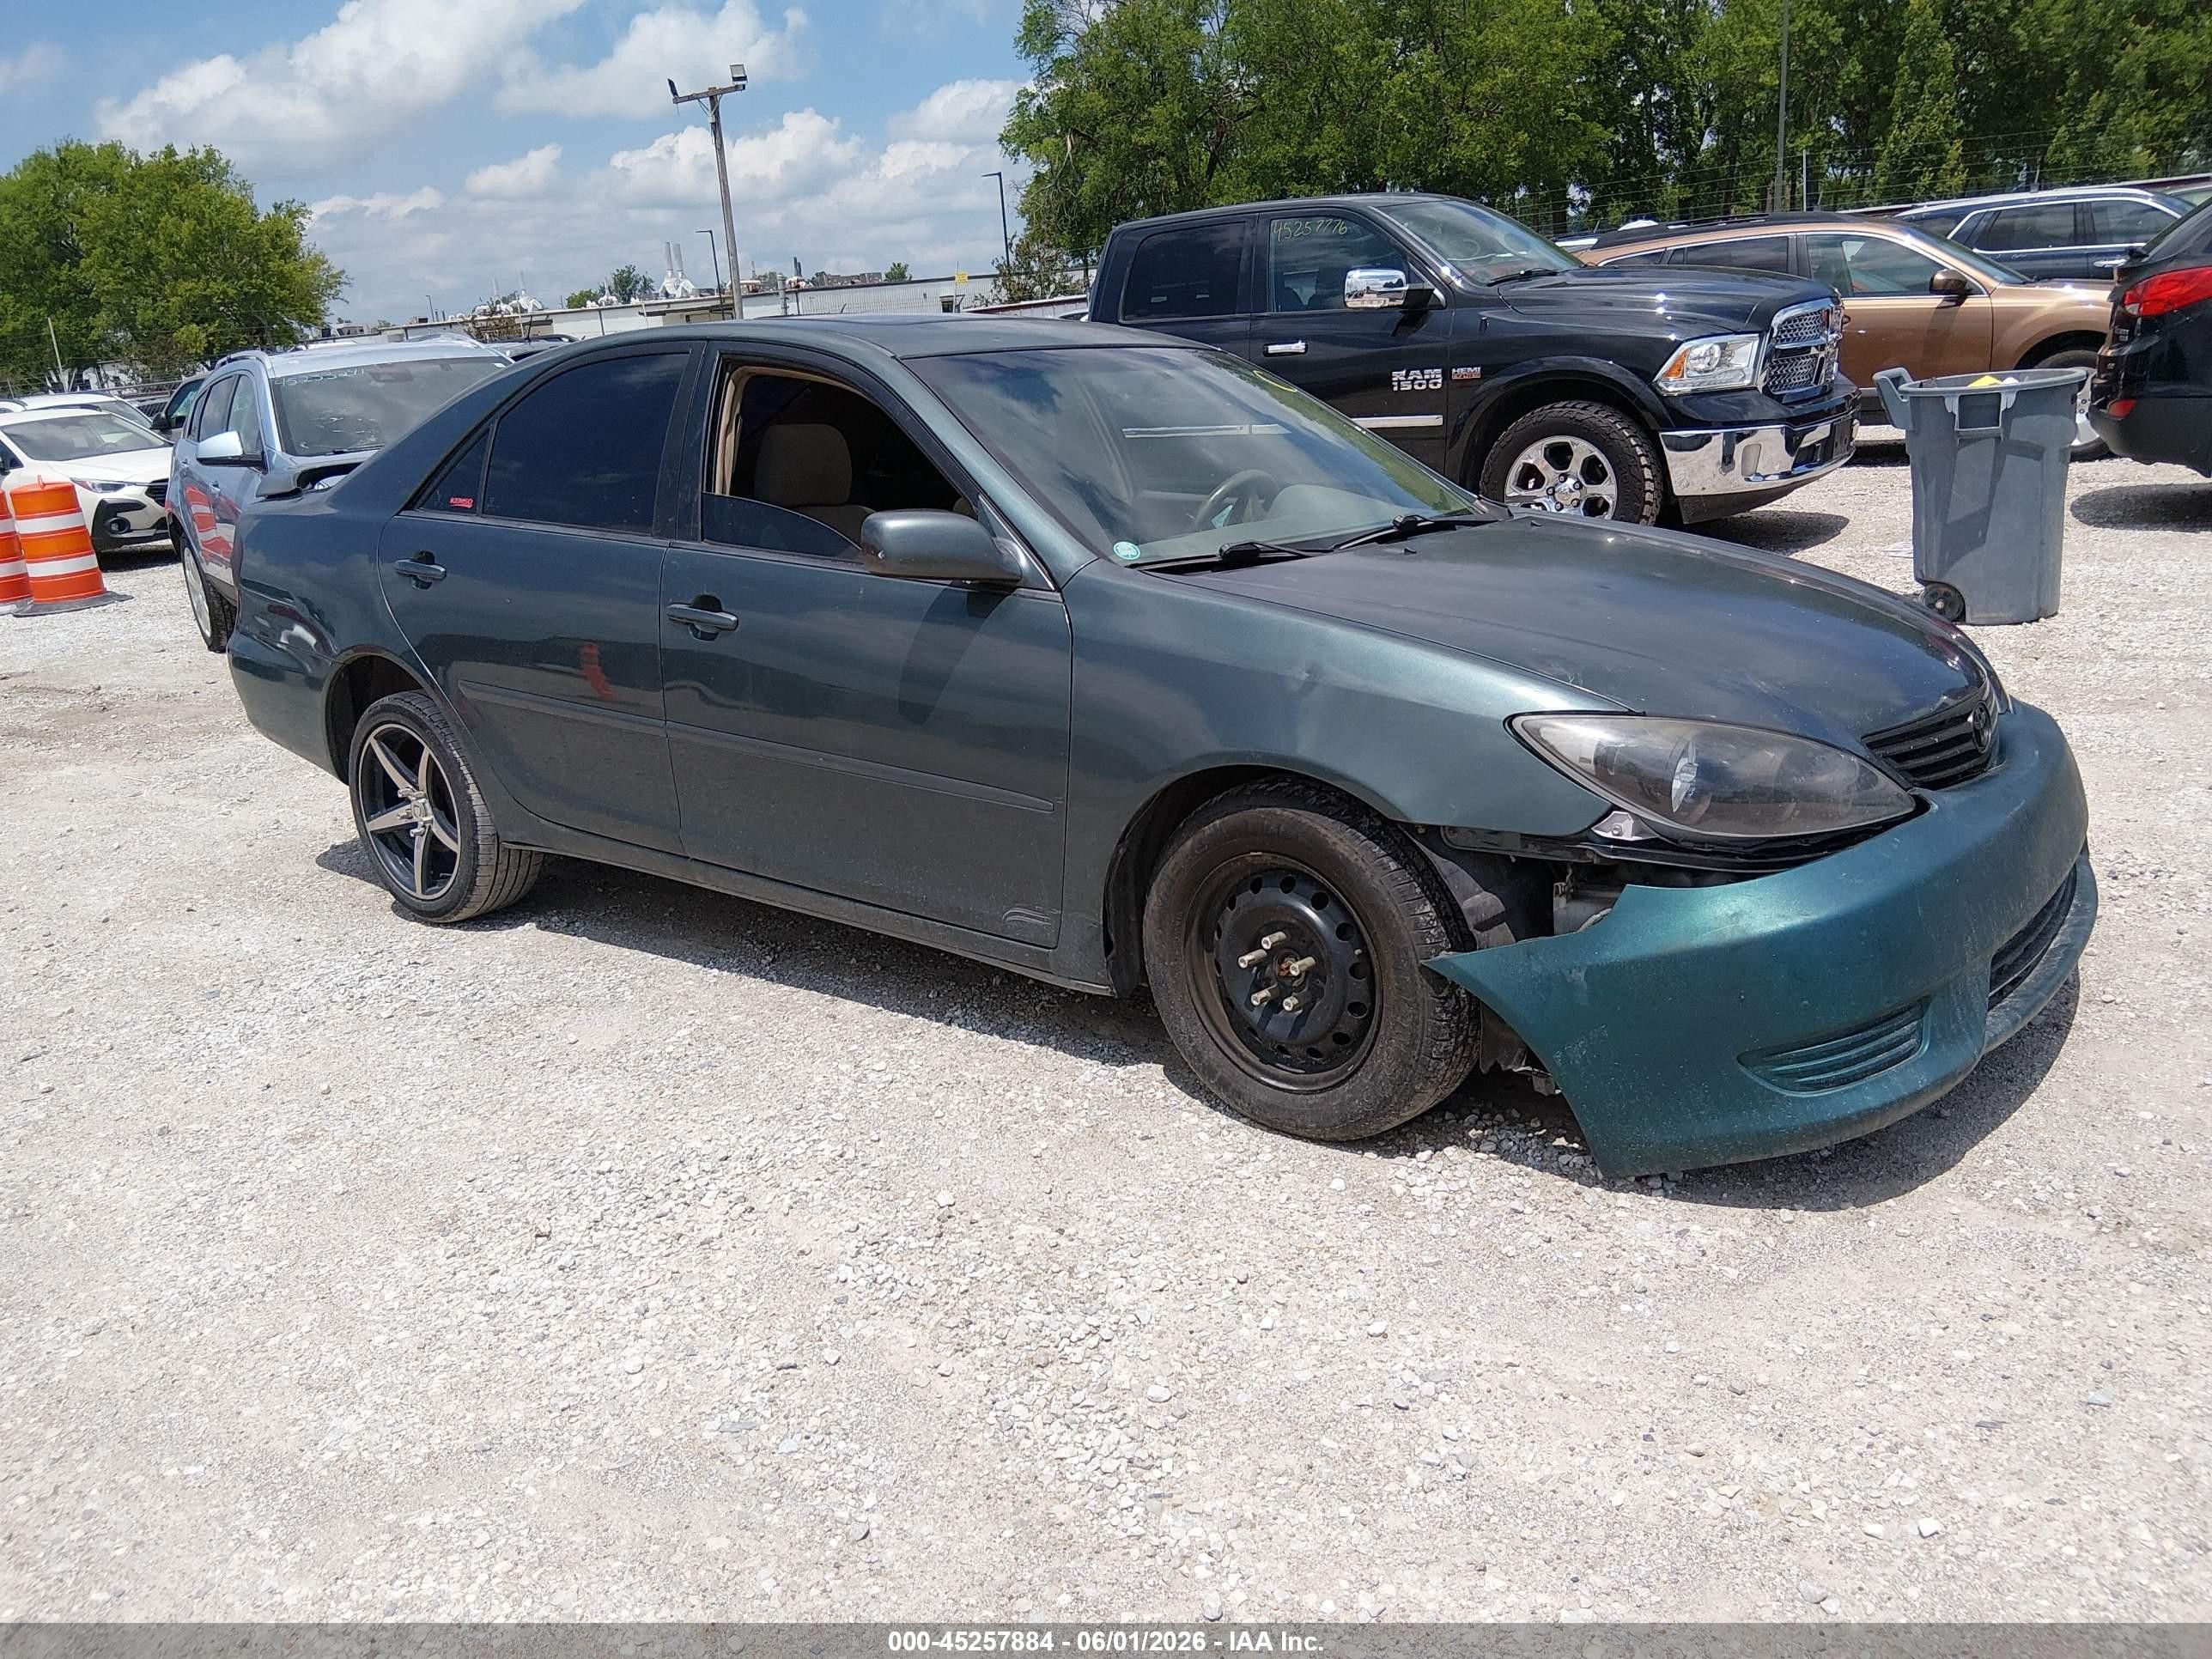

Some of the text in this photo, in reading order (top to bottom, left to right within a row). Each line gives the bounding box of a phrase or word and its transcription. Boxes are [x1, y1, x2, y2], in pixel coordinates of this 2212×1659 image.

[1273, 218, 1347, 241] 45257776
[1391, 368, 1443, 381] RAM
[1451, 367, 1481, 375] HEMI
[1391, 379, 1443, 392] 1500
